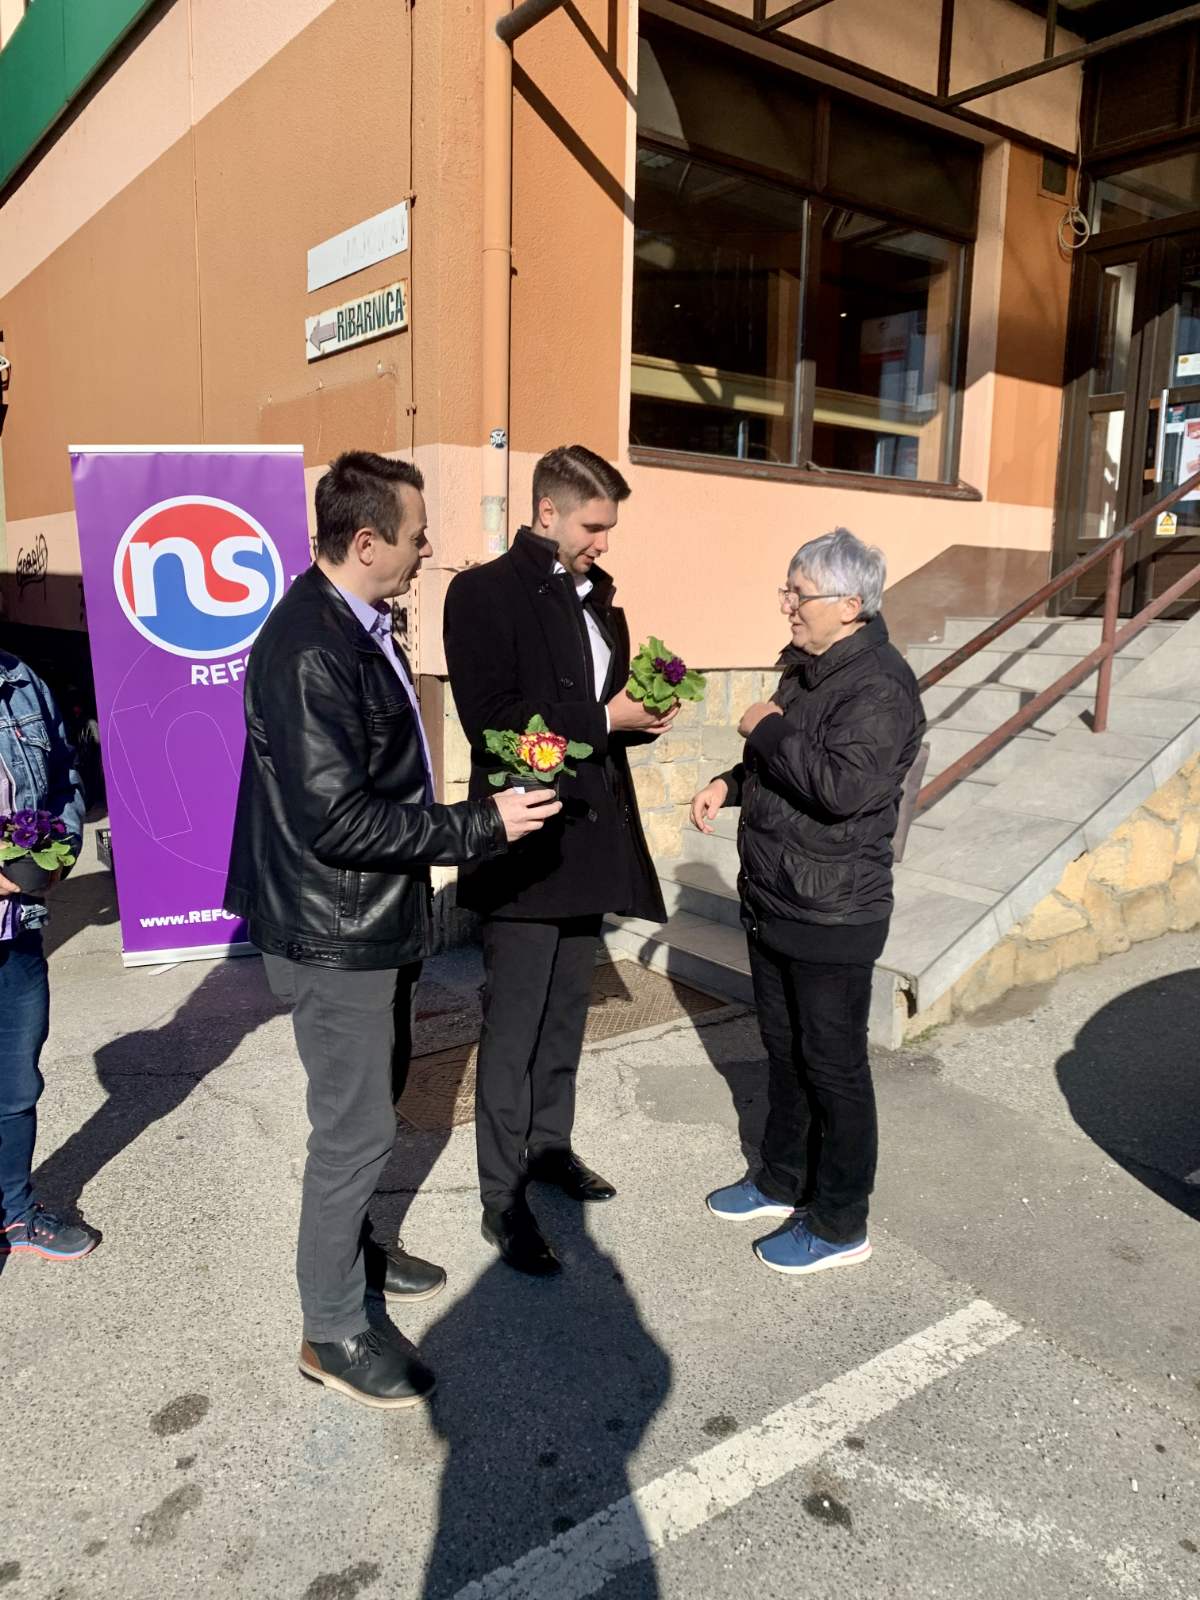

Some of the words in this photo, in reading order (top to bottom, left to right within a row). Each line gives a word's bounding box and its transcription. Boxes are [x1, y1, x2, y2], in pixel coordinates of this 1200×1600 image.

[336, 287, 404, 343] RIBARNICA
[129, 535, 270, 617] ns
[191, 653, 250, 686] REF
[140, 908, 241, 928] www.REFO
